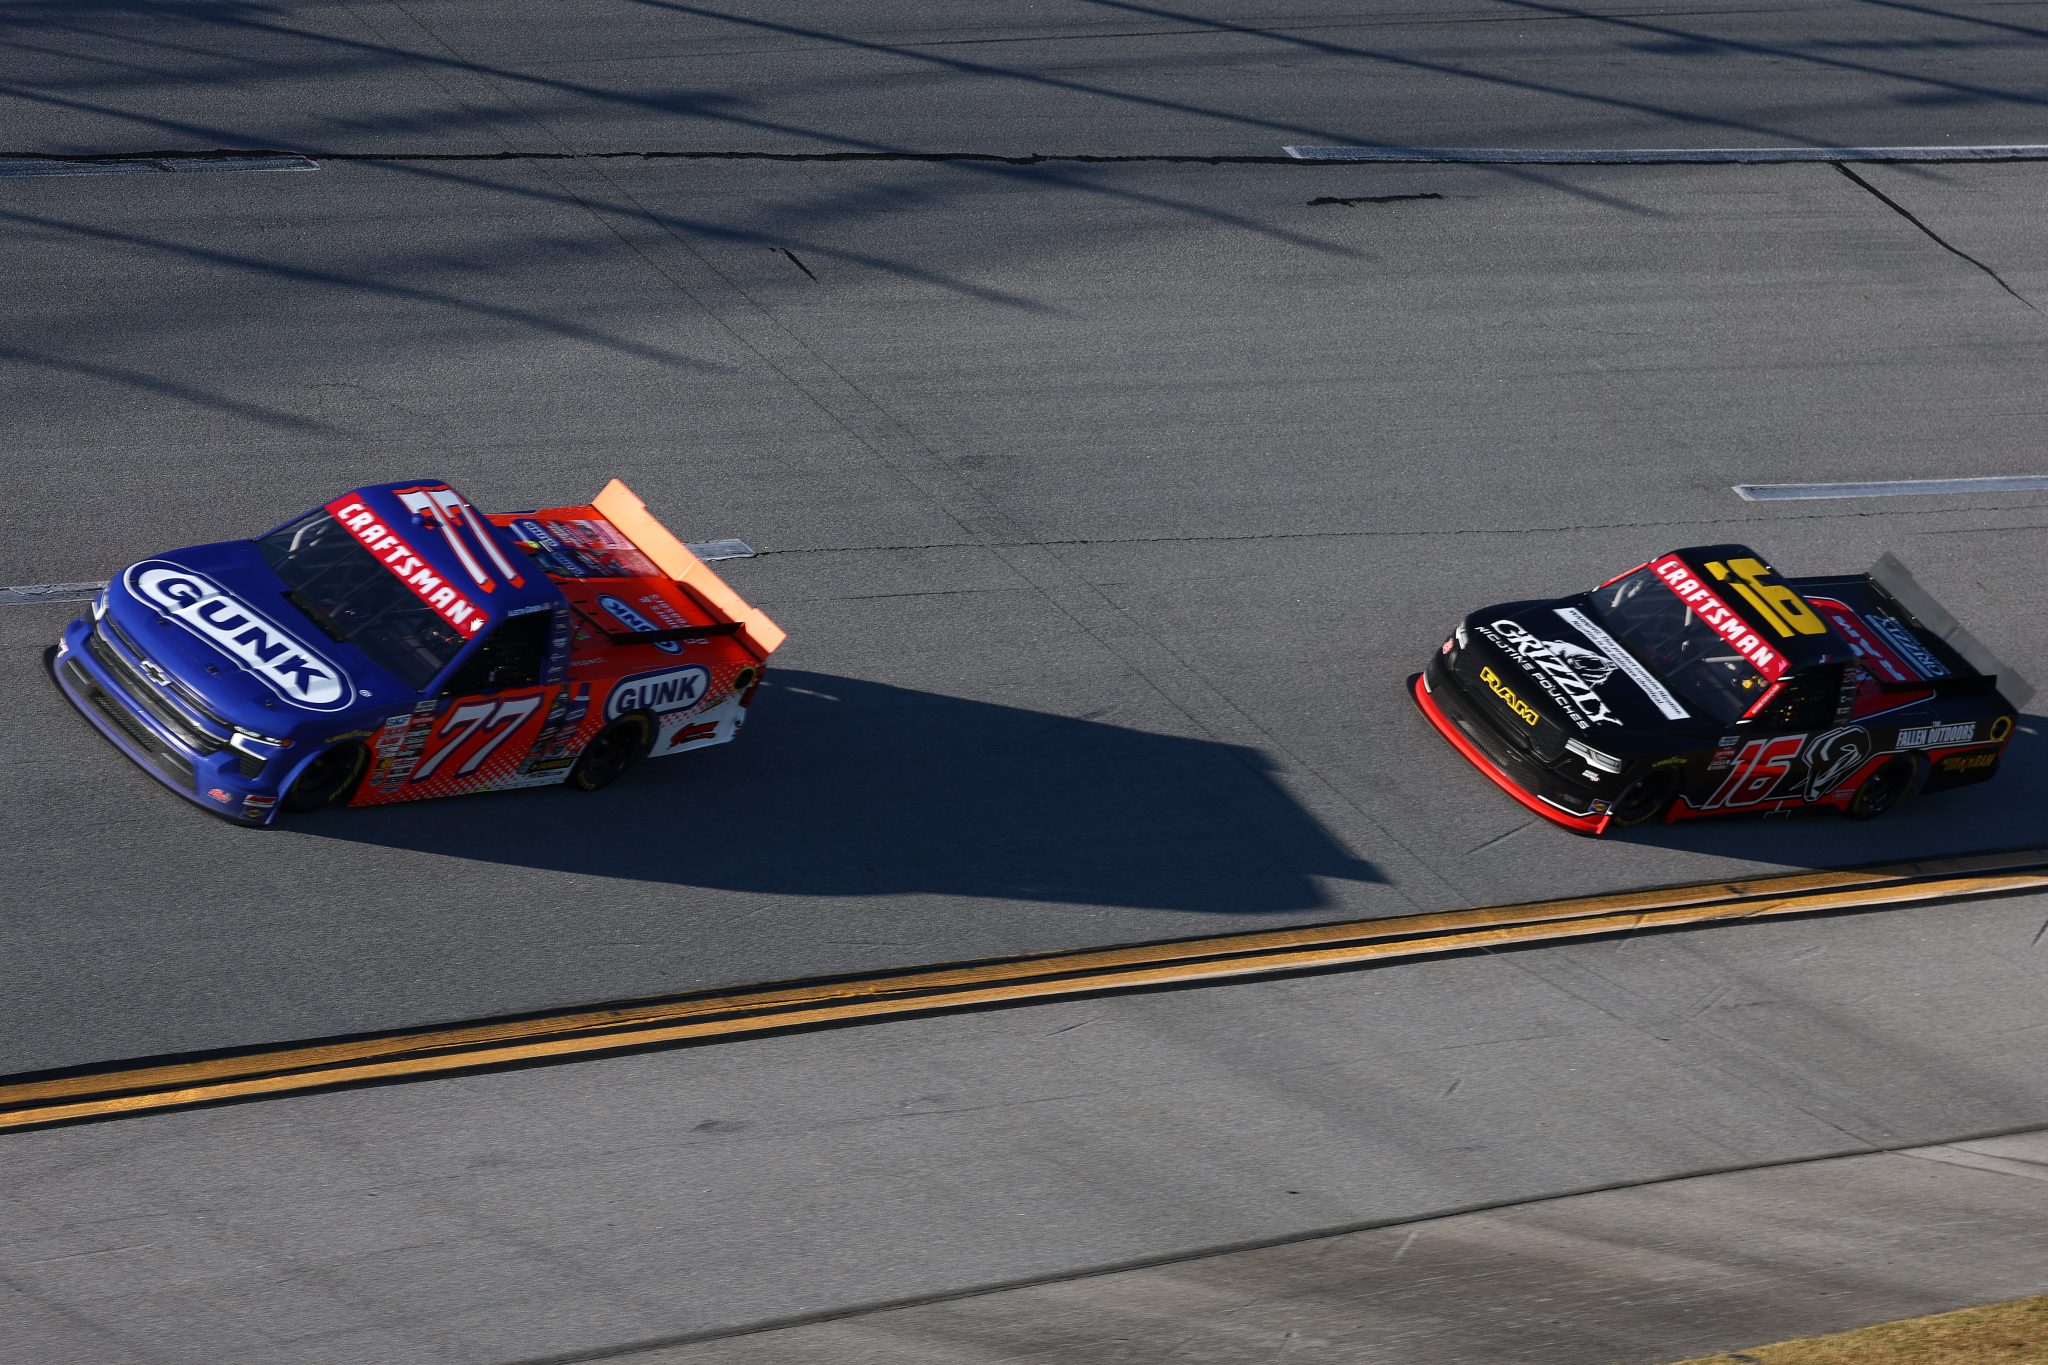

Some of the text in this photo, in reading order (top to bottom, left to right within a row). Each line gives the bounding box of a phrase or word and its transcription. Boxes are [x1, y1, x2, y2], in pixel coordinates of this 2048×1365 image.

[338, 502, 475, 626] CRAFTSMAN
[395, 486, 522, 590] 77
[156, 577, 332, 696] GUNK
[649, 604, 697, 645] Caners
[652, 593, 710, 645] Dreasers
[1656, 560, 1775, 669] CRAFTSMAN
[1703, 557, 1828, 639] 16
[615, 674, 700, 714] GUNK
[1474, 626, 1591, 730] NICOTINE POUCHES
[1479, 666, 1540, 726] RAM
[1490, 619, 1624, 727] GRIZZLY
[410, 693, 545, 783] 77
[1700, 733, 1808, 811] 16
[1896, 724, 1976, 747] FALLEN OUTDOORS
